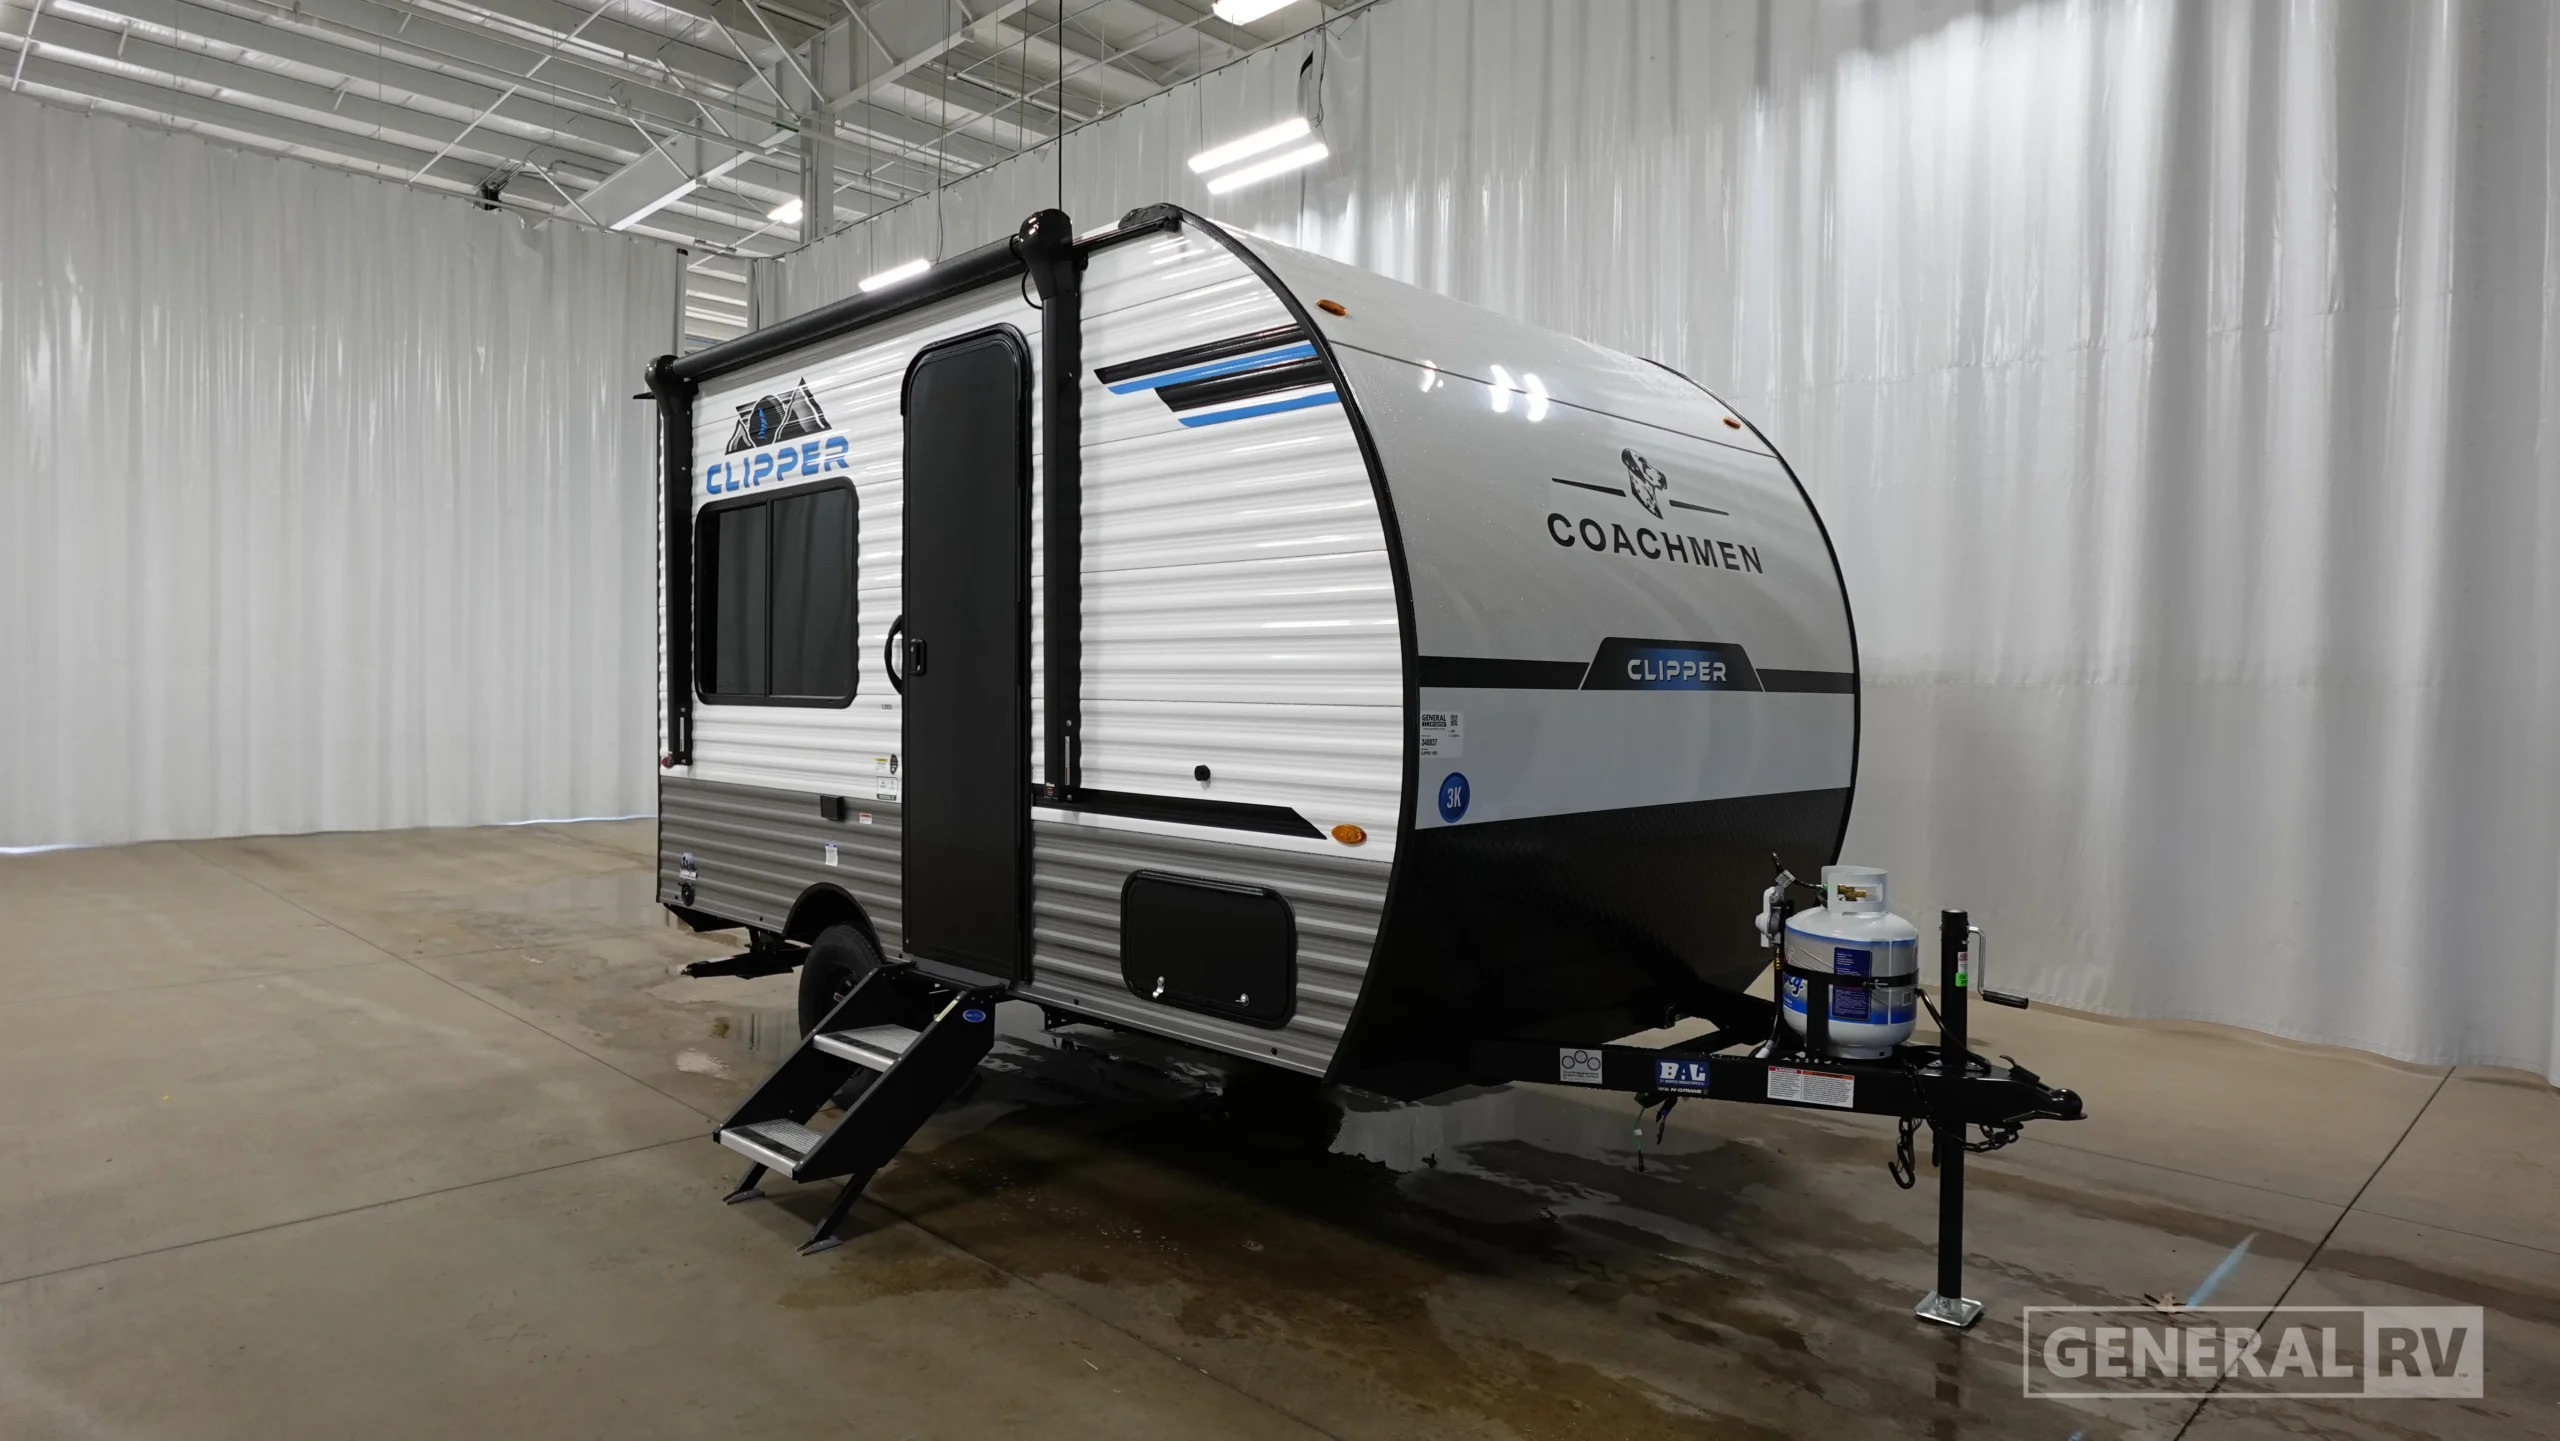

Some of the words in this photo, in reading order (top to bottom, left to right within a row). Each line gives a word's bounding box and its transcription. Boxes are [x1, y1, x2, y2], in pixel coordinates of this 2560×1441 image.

[706, 436, 849, 495] CLIPPER
[1547, 513, 1763, 574] COACHMEN
[1627, 659, 1727, 682] CLIPPER
[1447, 787, 1462, 808] 3K
[1660, 1062, 1706, 1081] BAL
